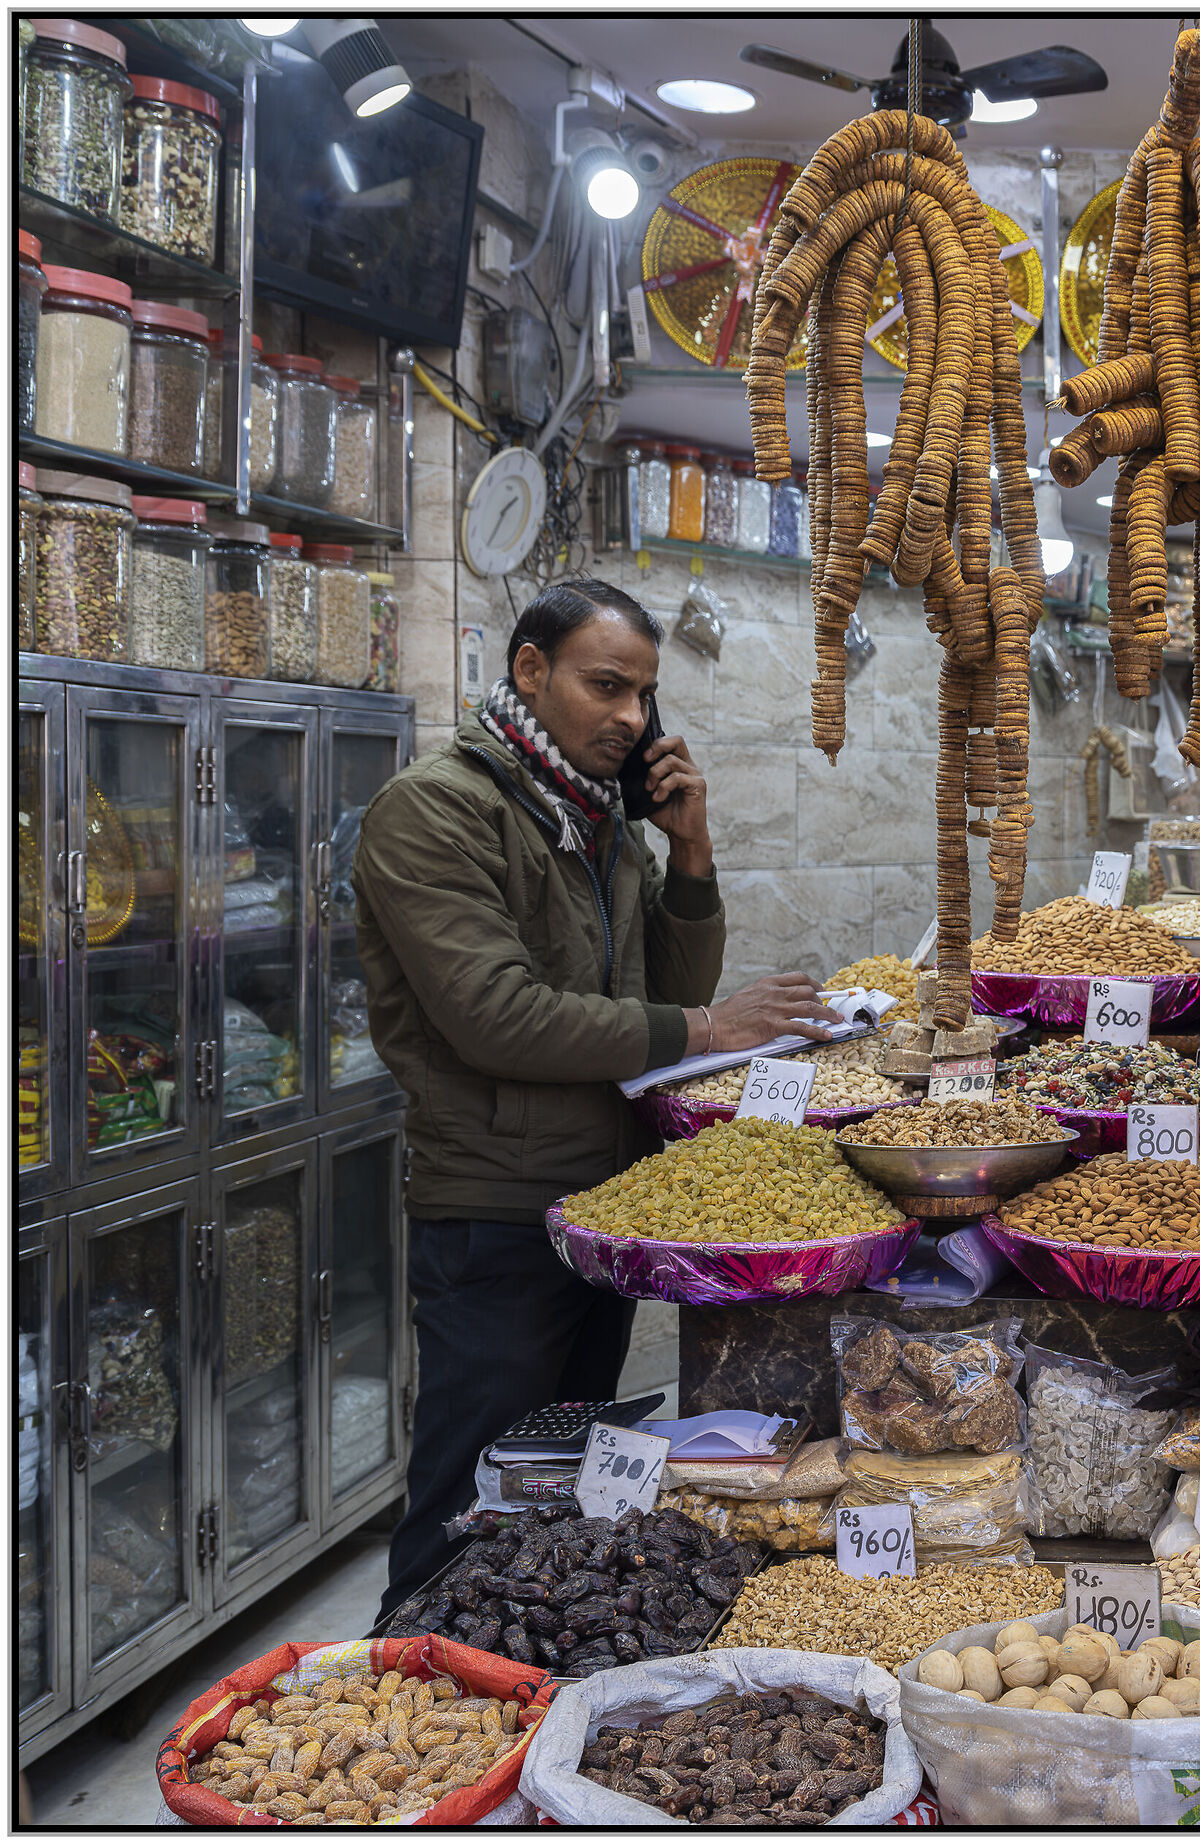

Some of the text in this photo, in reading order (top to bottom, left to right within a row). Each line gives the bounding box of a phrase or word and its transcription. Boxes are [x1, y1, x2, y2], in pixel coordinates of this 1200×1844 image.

[1096, 1001, 1141, 1028] 600
[752, 1059, 769, 1074] Rs
[1131, 1107, 1156, 1127] Rs
[1137, 1128, 1193, 1158] 800
[595, 1428, 617, 1448] Rs
[840, 1509, 861, 1527] Rs
[1071, 1567, 1103, 1587] Rs.
